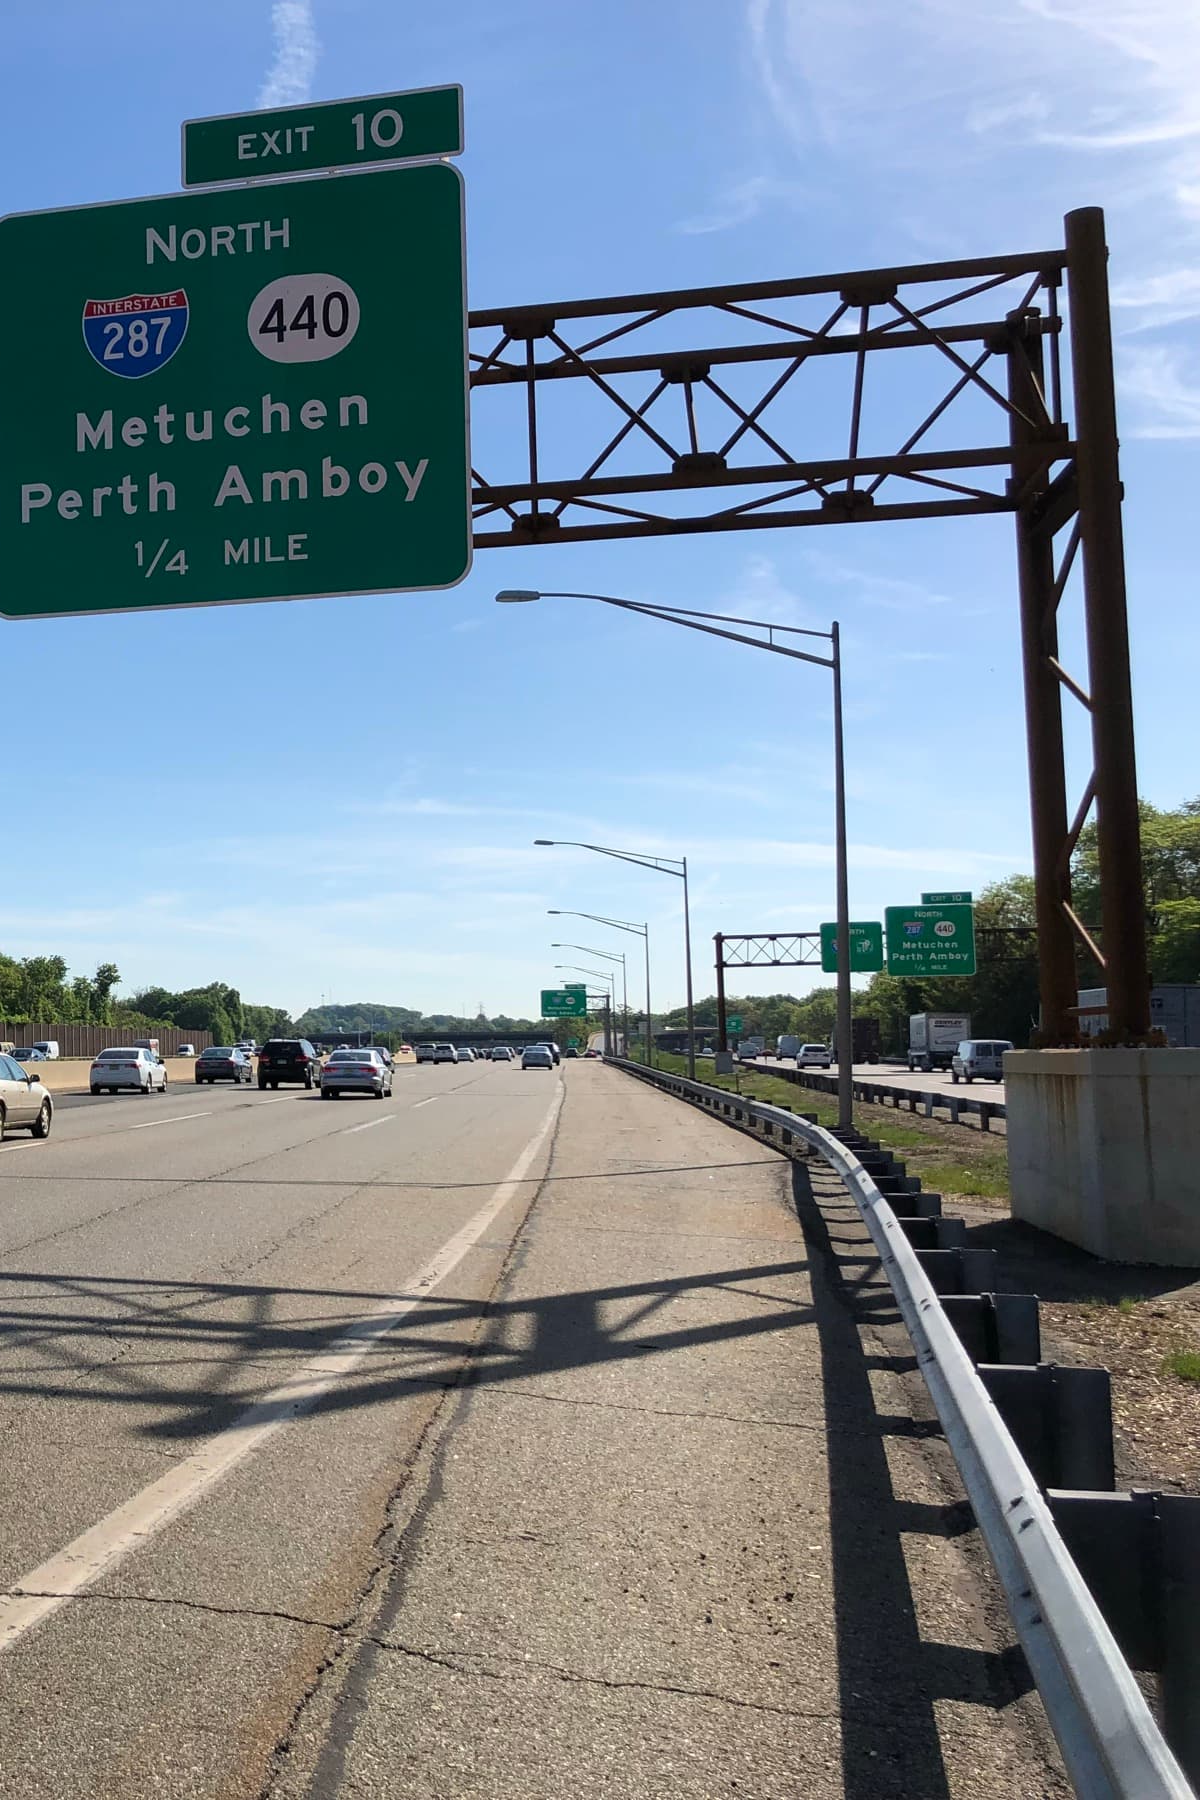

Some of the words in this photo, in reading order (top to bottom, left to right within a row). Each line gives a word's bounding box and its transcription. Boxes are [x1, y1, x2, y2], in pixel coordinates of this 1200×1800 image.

[237, 125, 315, 160] EXIT
[351, 108, 404, 151] 10
[145, 217, 291, 265] NORTH
[92, 294, 178, 315] INTERSTATE
[102, 317, 172, 361] 287
[258, 290, 349, 343] 440
[76, 393, 369, 453] Metuchen
[20, 471, 176, 524] Perth
[213, 455, 430, 508] Amboy
[133, 538, 189, 578] 1/4
[223, 533, 309, 566] MILE
[951, 894, 962, 902] 10
[902, 940, 958, 949] Metuchen
[906, 926, 921, 935] 287
[936, 923, 953, 933] 440
[892, 952, 923, 961] Perth
[929, 951, 969, 961] Amboy
